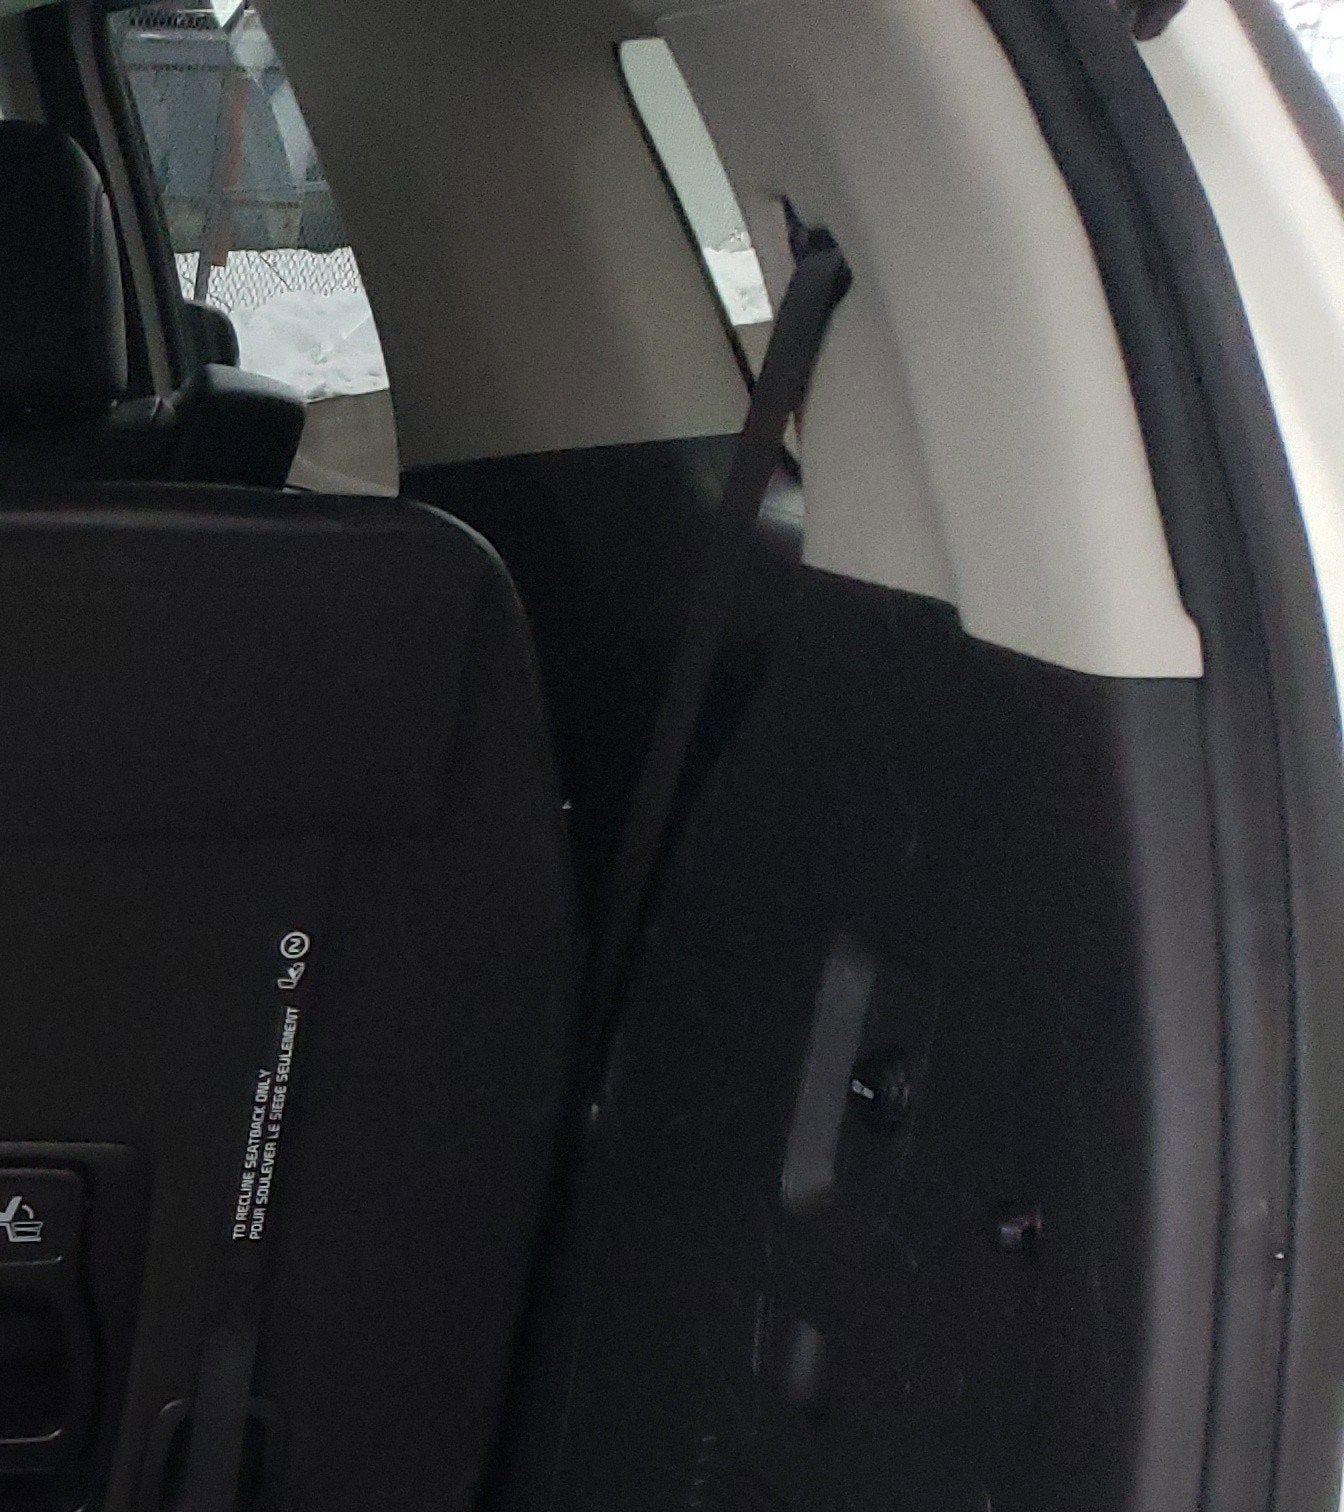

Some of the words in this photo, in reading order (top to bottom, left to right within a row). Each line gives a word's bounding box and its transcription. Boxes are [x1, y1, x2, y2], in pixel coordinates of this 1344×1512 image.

[276, 1007, 301, 1082] SEULEMENT
[255, 1069, 272, 1103] ONLY
[245, 1105, 266, 1168] SEATBACK
[267, 1123, 281, 1139] LE
[256, 1141, 277, 1205] SOULEVER
[236, 1172, 255, 1220] RECLINE
[232, 1224, 246, 1240] TO
[249, 1208, 266, 1240] POUR
